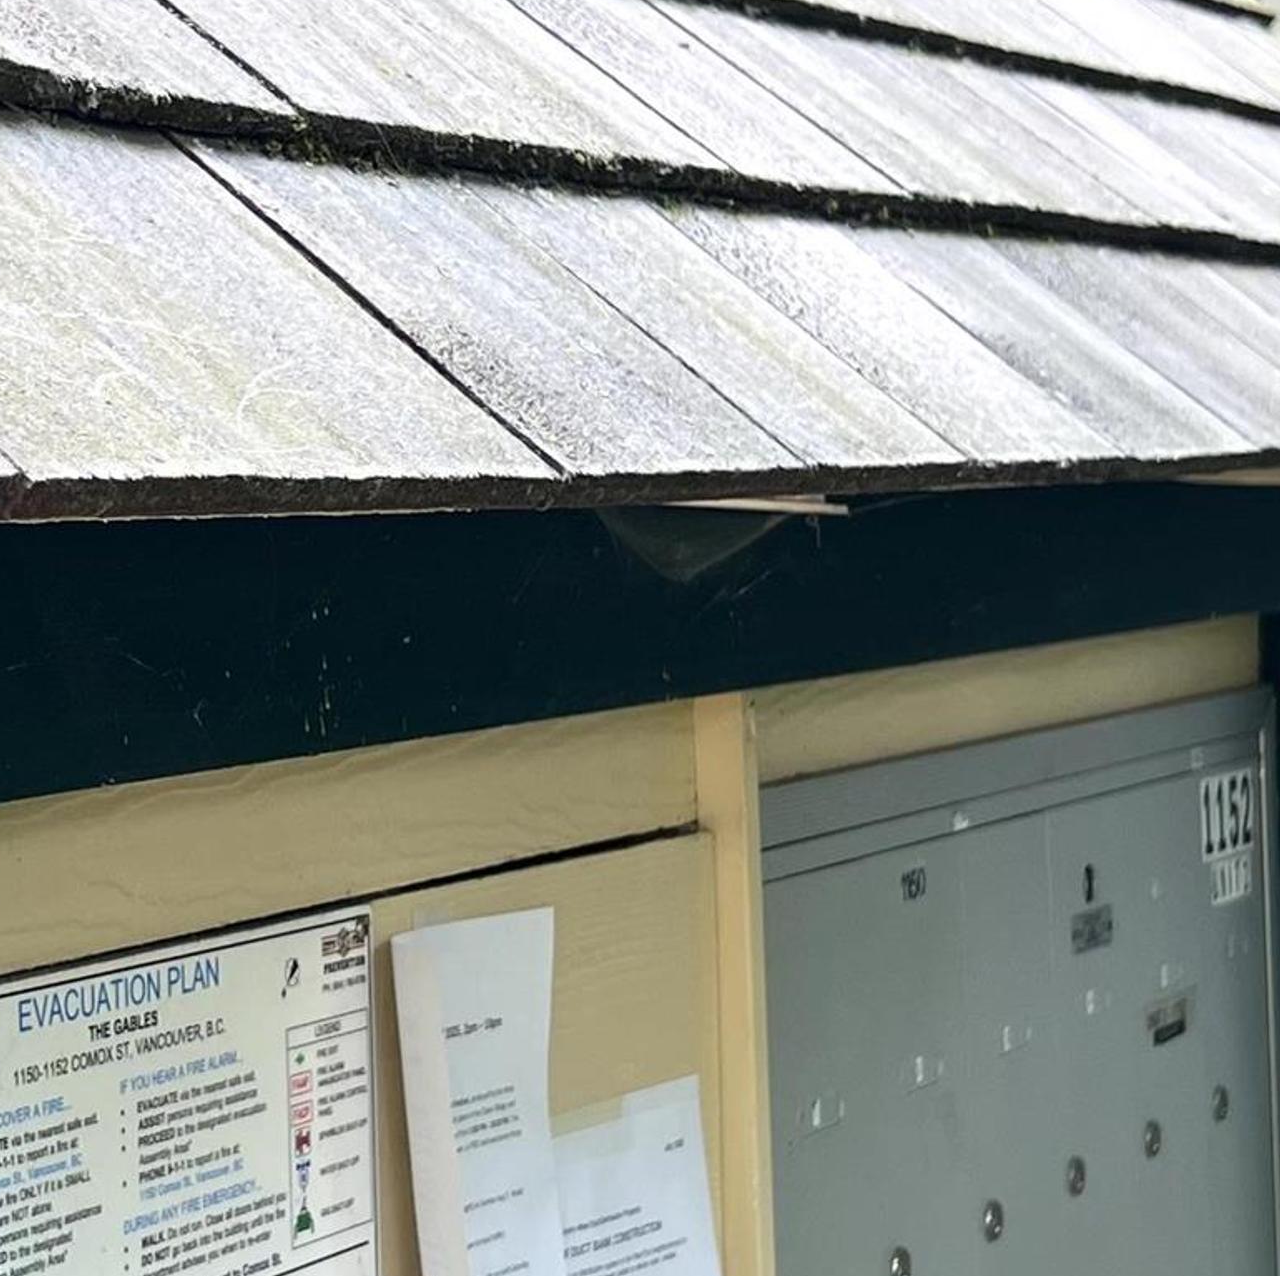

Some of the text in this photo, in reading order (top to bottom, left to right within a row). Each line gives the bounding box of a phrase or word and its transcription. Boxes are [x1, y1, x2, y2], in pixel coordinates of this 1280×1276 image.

[1203, 775, 1251, 855] 1152
[18, 956, 220, 1033] EVACUATION PLAN
[88, 1009, 159, 1042] THE GABLES
[12, 1056, 69, 1088] 1150-1152
[70, 1044, 114, 1071] COMOX
[136, 1090, 179, 1113] EVACUATE
[137, 1126, 176, 1147] PROCEED
